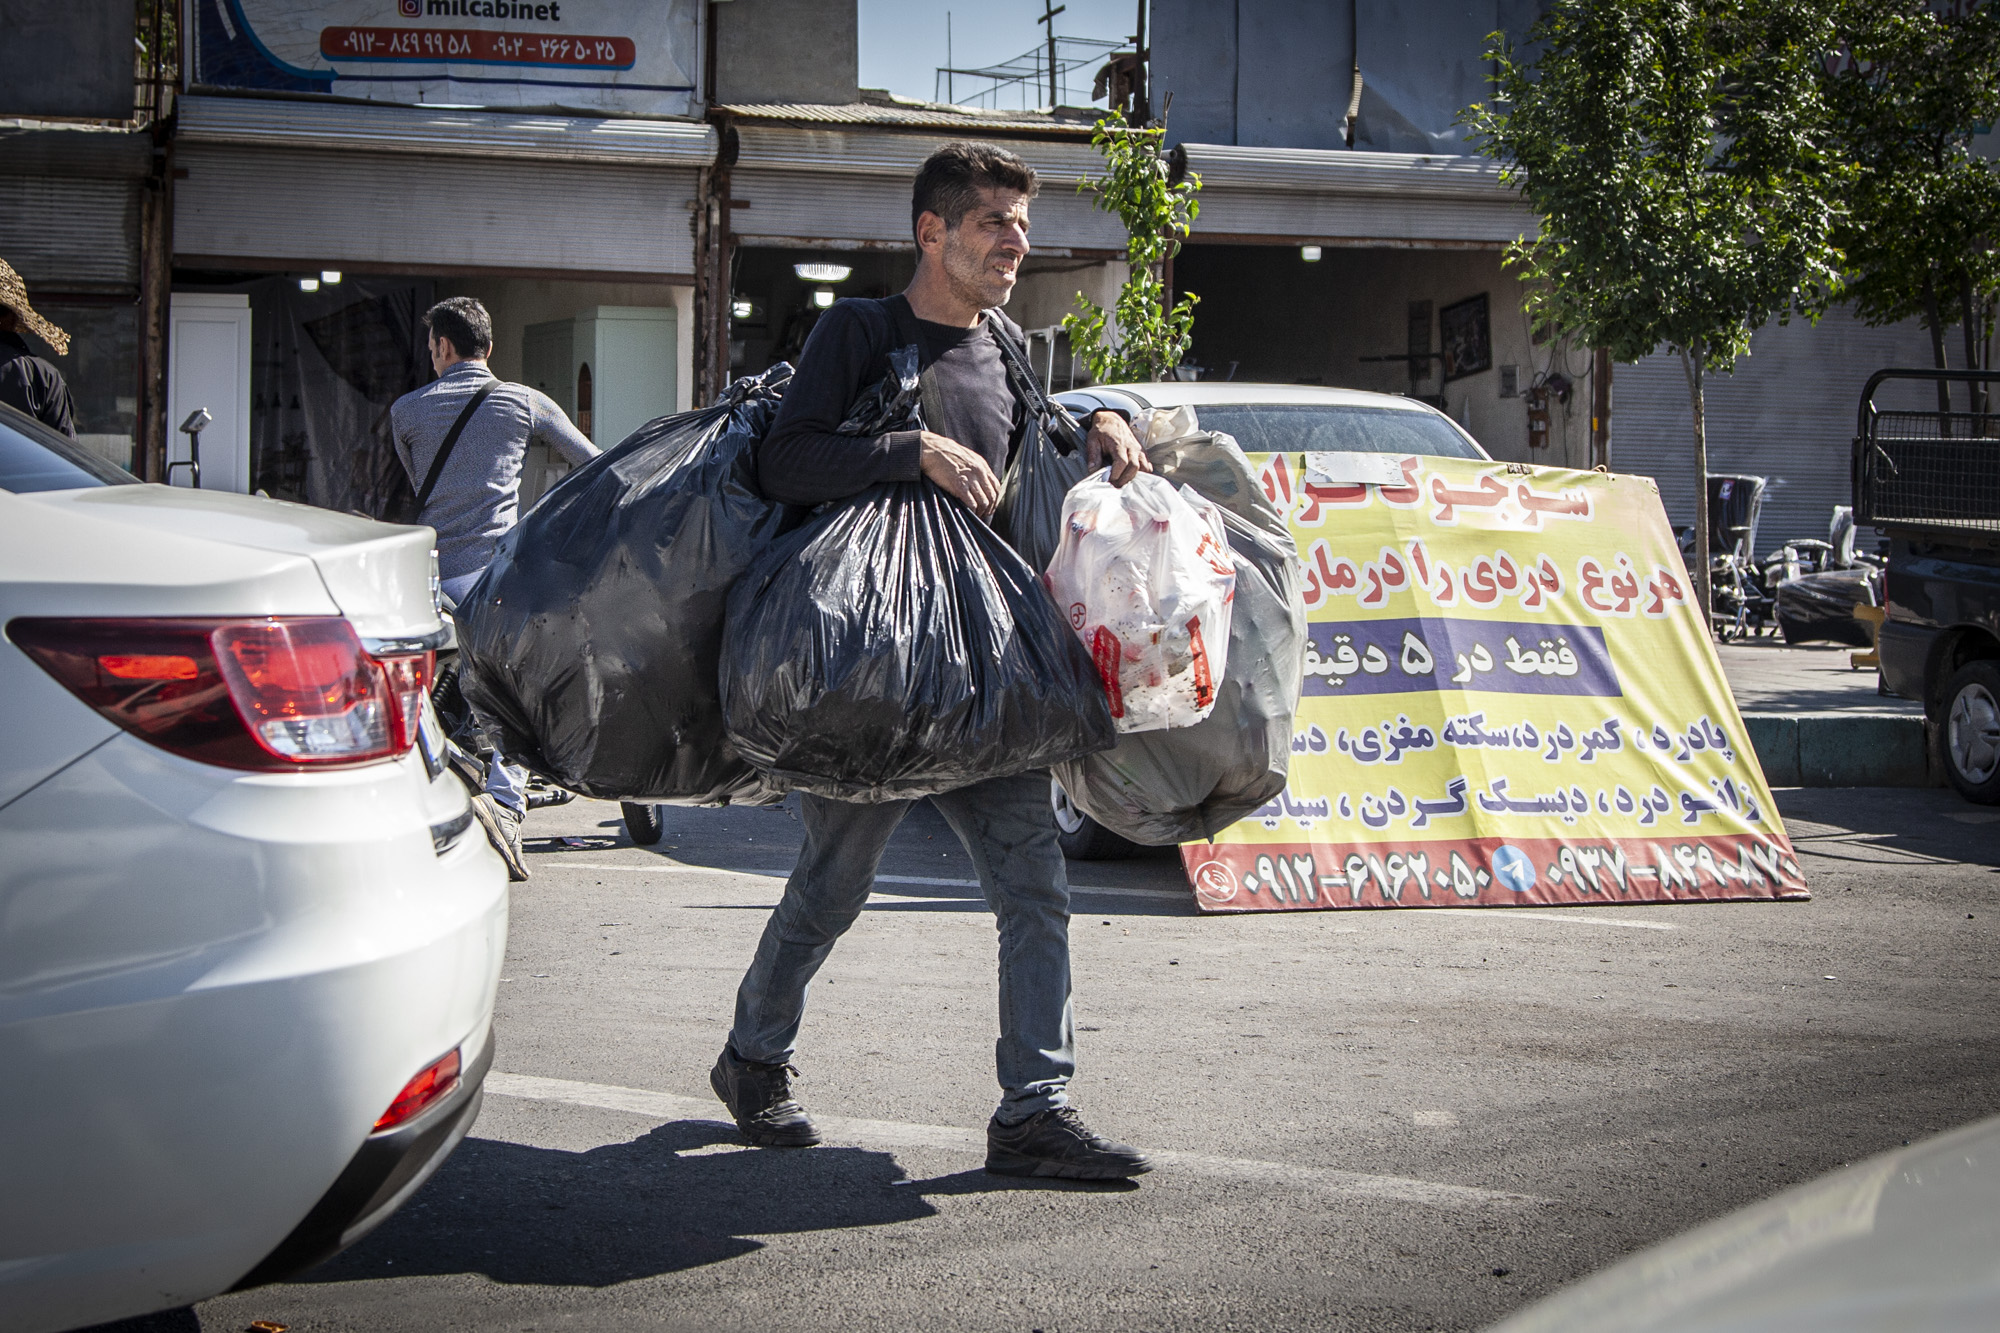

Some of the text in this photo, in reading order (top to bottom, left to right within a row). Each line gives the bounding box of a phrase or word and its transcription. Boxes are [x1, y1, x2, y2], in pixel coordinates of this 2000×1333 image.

[427, 0, 560, 21] milcabinet
[1582, 557, 1639, 612] نوع
[1401, 632, 1433, 674] ۵
[1452, 643, 1493, 682] در
[1505, 637, 1578, 676] فقط
[1479, 779, 1588, 822] دیسک
